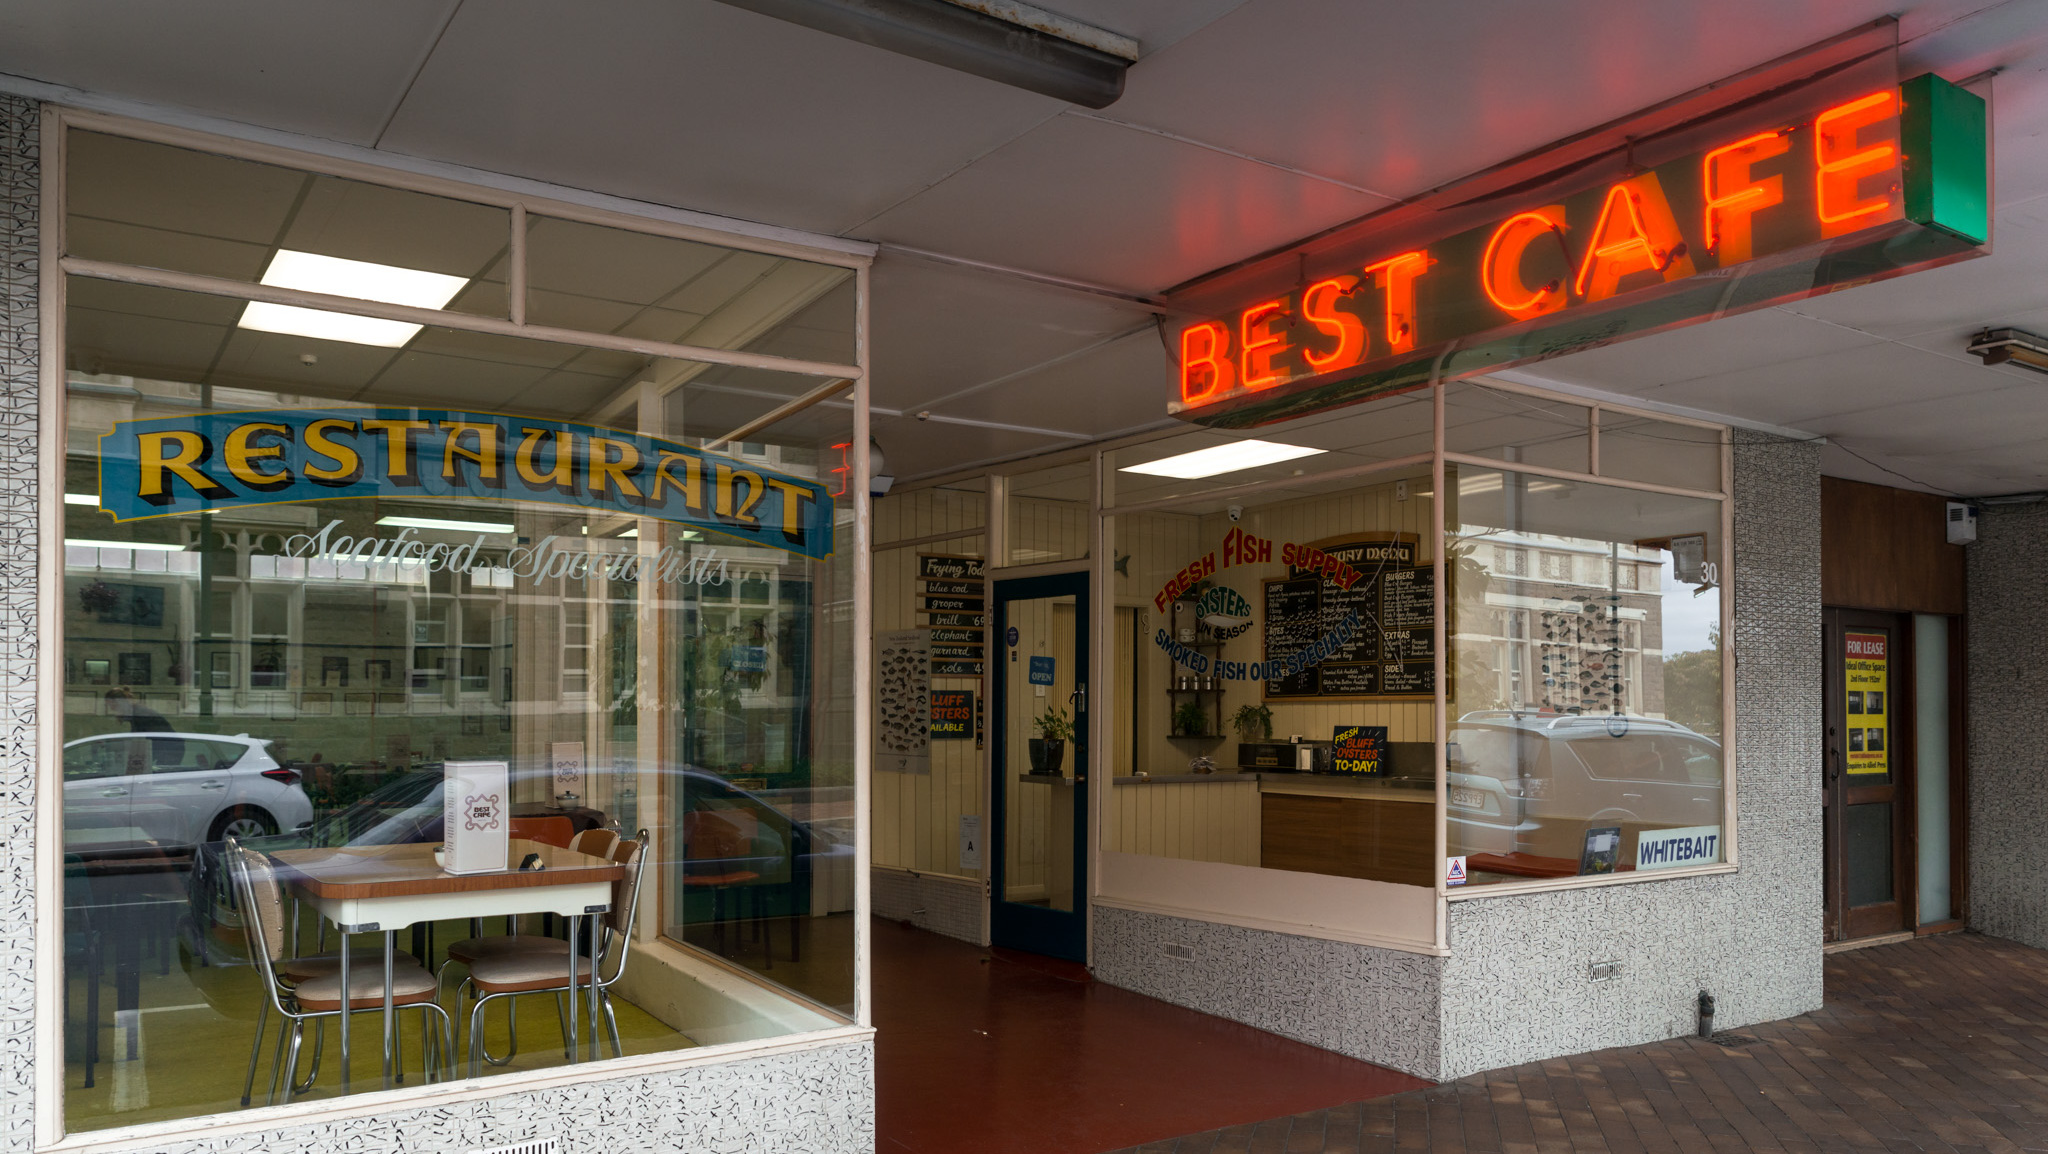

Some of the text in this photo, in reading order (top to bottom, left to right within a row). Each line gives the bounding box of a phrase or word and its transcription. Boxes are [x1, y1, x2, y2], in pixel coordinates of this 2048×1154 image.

[1182, 88, 1902, 405] BEST CAFE
[136, 418, 817, 547] RESTAURANT
[285, 519, 731, 587] Seafood Specialists
[926, 558, 966, 578] Frying
[1154, 551, 1216, 615] FRESH
[1223, 526, 1272, 569] FISH
[1281, 542, 1363, 592] SUPPLY
[1385, 570, 1415, 582] BURGERS
[929, 582, 970, 594] blue cod
[932, 599, 965, 610] groper
[1195, 586, 1252, 620] OYSTERS
[936, 613, 962, 626] brill
[931, 630, 973, 642] elephant
[1200, 622, 1212, 636] IN
[1213, 619, 1254, 641] SEASON
[1384, 630, 1411, 640] EXTRAS
[1155, 628, 1210, 675] SMOKED
[1213, 659, 1247, 681] FISH
[1250, 659, 1283, 681] OUR
[1285, 606, 1362, 675] SPECIALTY
[1847, 640, 1885, 655] FOR LEASE
[930, 647, 971, 658] gurnard
[937, 662, 963, 674] sole
[1872, 663, 1886, 673] Space
[1031, 671, 1053, 682] OPEN
[931, 694, 965, 706] LUFF
[1334, 726, 1360, 745] FRESH
[1345, 737, 1375, 749] BLUFF
[1336, 747, 1378, 760] OYSTERS
[1334, 759, 1378, 773] TO-DAY!
[967, 841, 974, 852] A
[1640, 835, 1717, 866] WHITEBAIT
